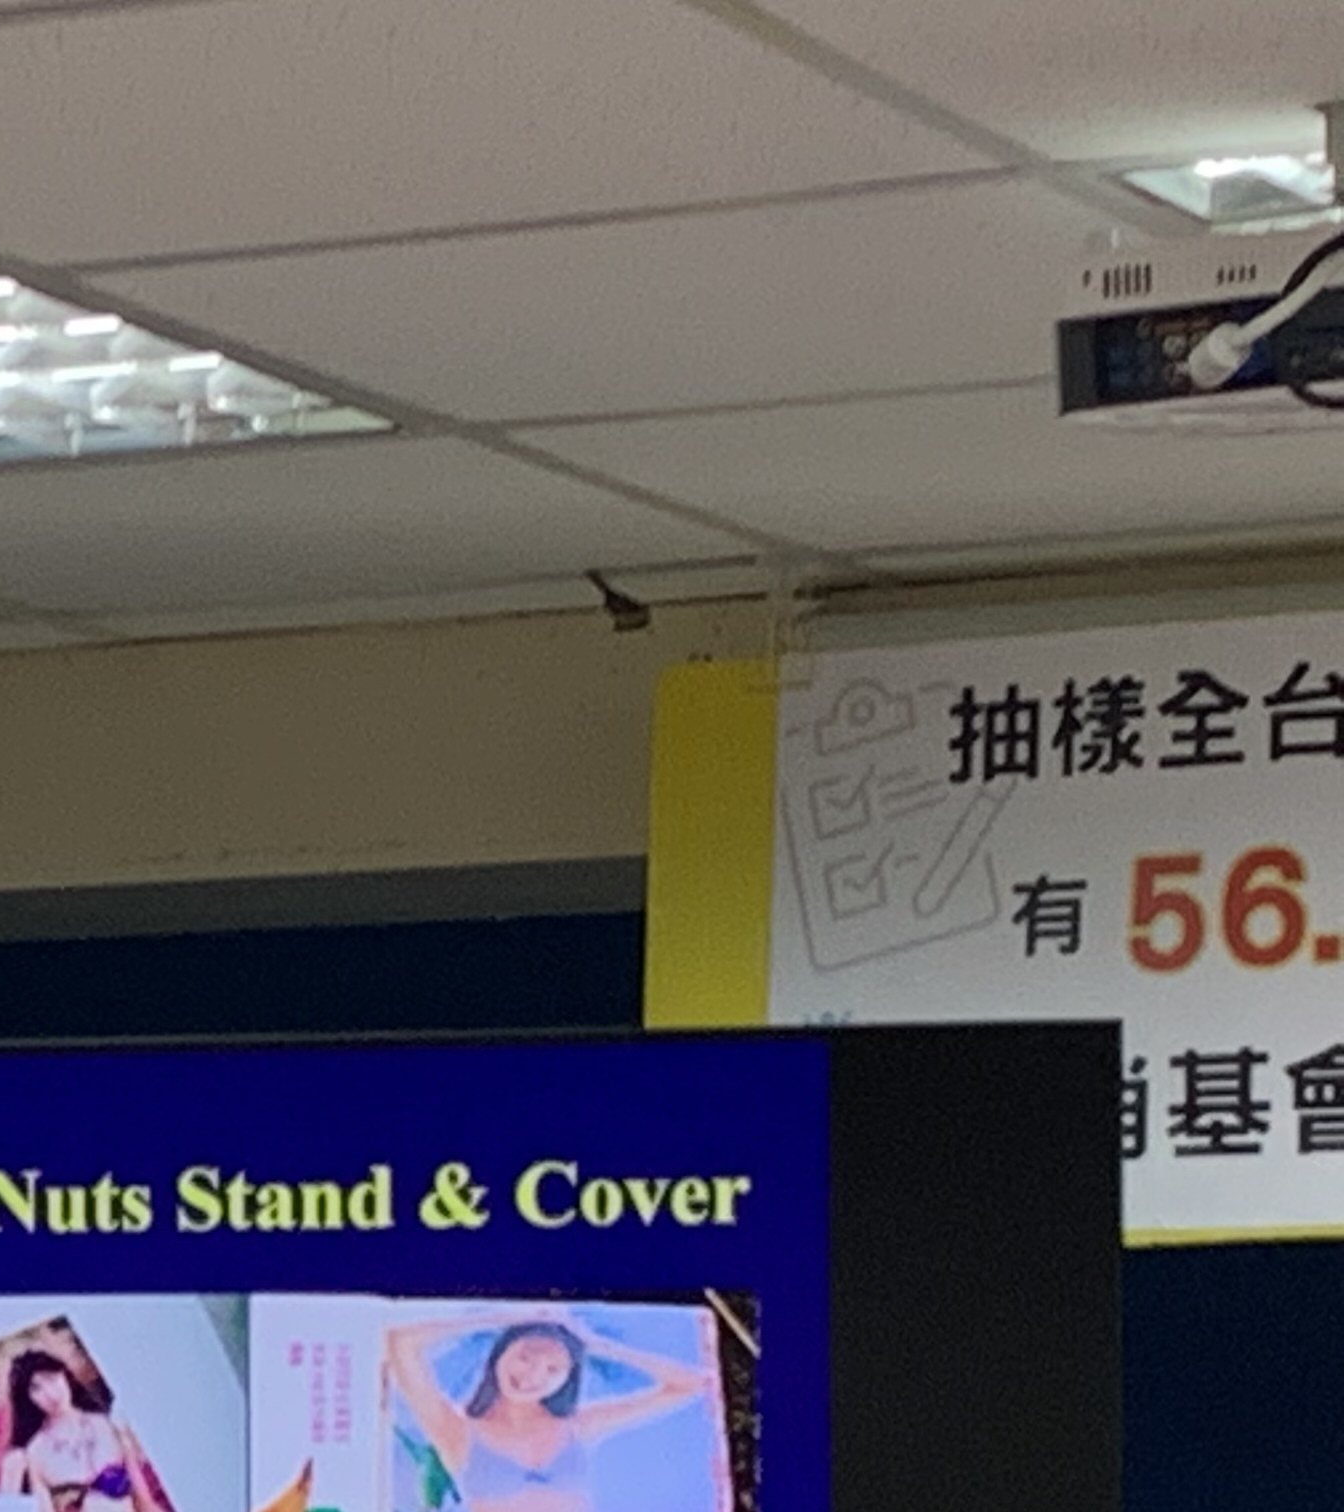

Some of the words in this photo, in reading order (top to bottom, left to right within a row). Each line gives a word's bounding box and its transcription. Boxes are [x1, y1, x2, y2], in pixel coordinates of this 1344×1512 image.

[948, 661, 1344, 784] 抽樣全台
[1011, 873, 1088, 958] 有
[1127, 844, 1342, 974] 56.
[1122, 1044, 1344, 1160] 基會
[177, 1164, 394, 1232] Stand
[419, 1161, 490, 1230] &
[515, 1159, 752, 1229] Cover
